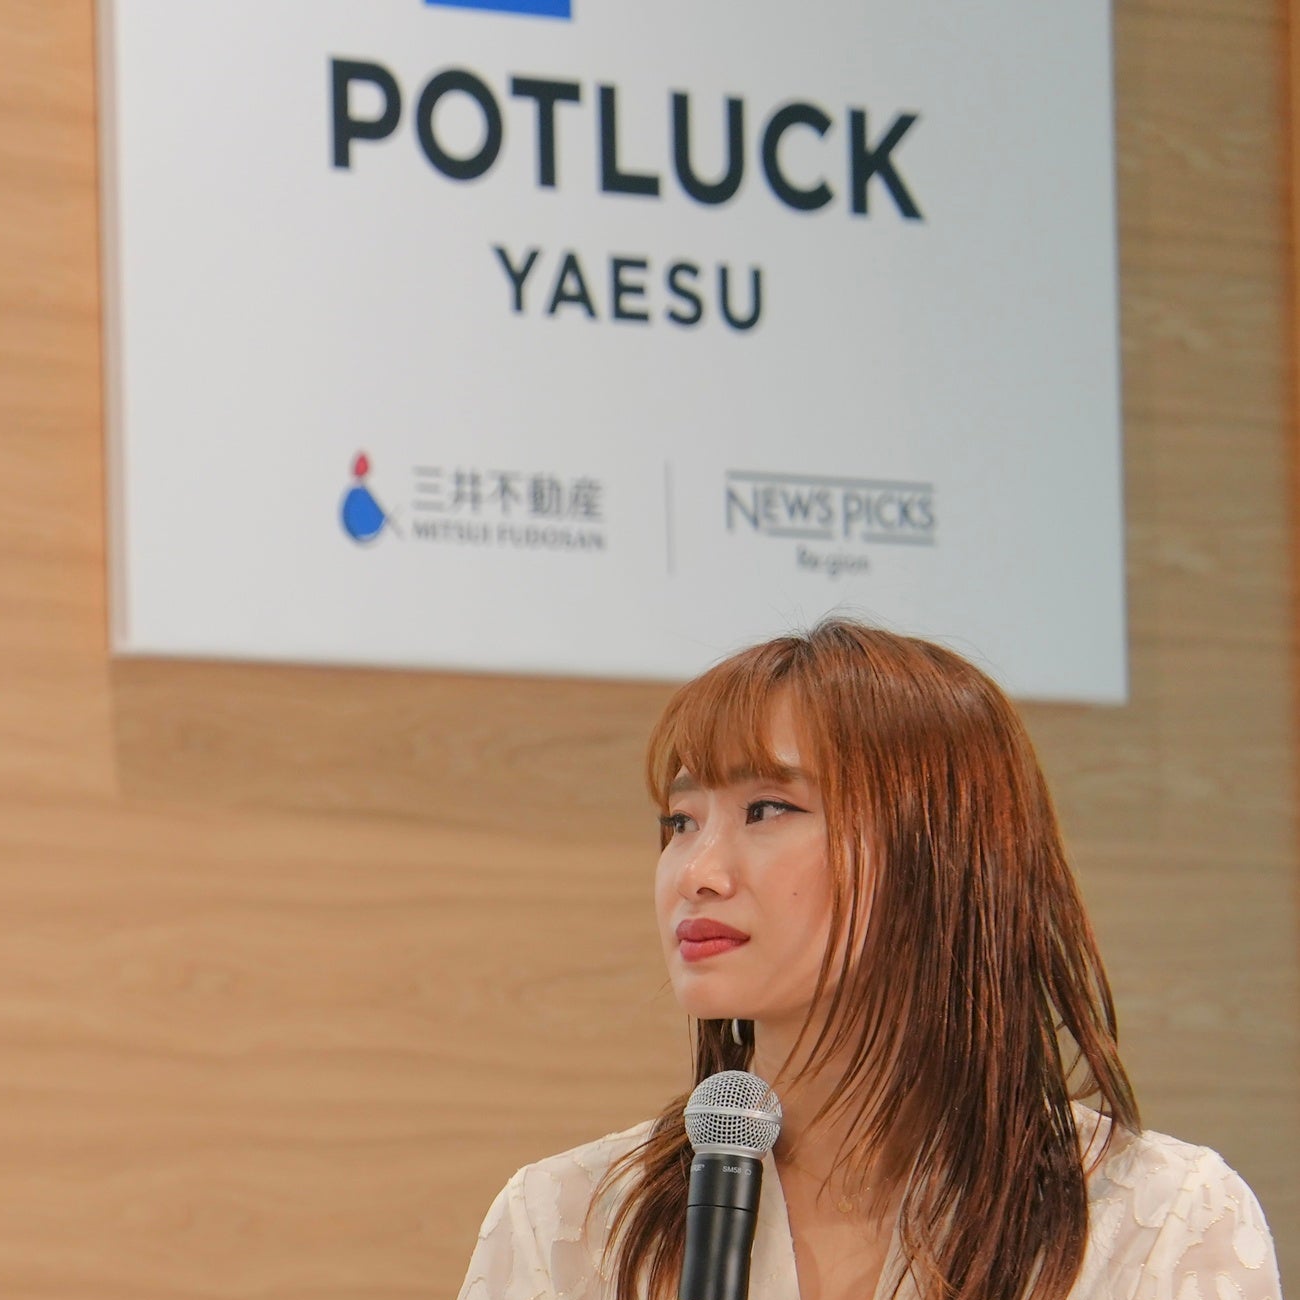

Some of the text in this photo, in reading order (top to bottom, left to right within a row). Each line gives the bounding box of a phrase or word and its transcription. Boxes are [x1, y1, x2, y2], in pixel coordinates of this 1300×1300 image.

[328, 56, 926, 221] POTLUCK
[494, 245, 764, 330] YAESU
[411, 466, 604, 518] 三井不動産
[725, 484, 935, 536] NEWS PICKS
